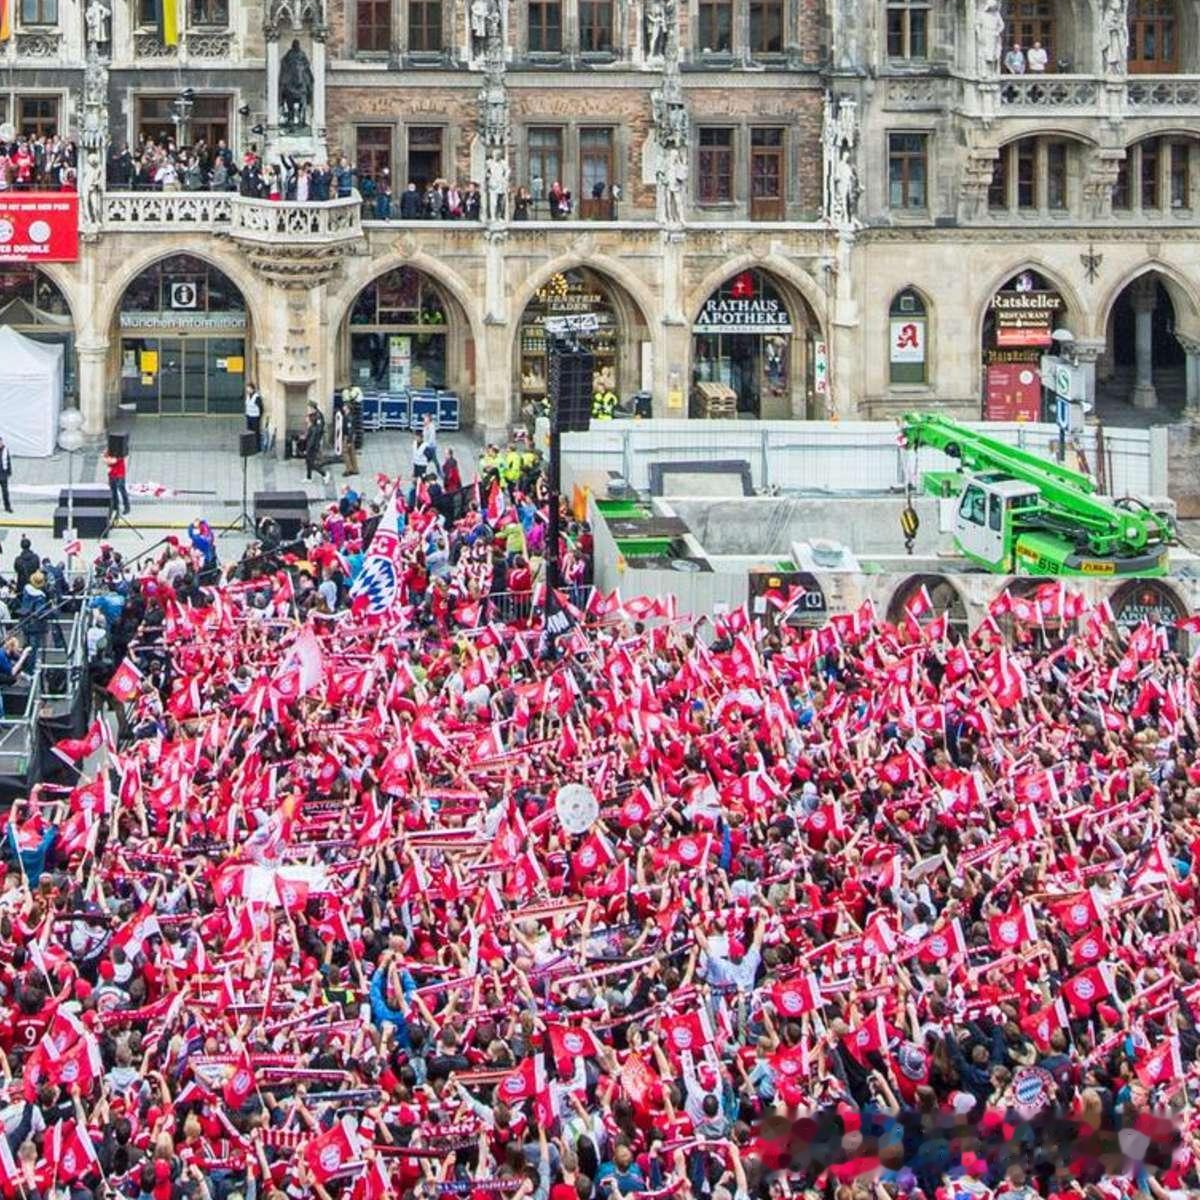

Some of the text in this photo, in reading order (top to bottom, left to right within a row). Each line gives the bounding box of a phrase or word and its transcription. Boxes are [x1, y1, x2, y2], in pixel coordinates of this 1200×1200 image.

[707, 300, 778, 312] RATHAUS
[992, 294, 1060, 308] Ratskeller
[698, 310, 787, 323] APOTHEKE
[24, 1026, 36, 1046] 9
